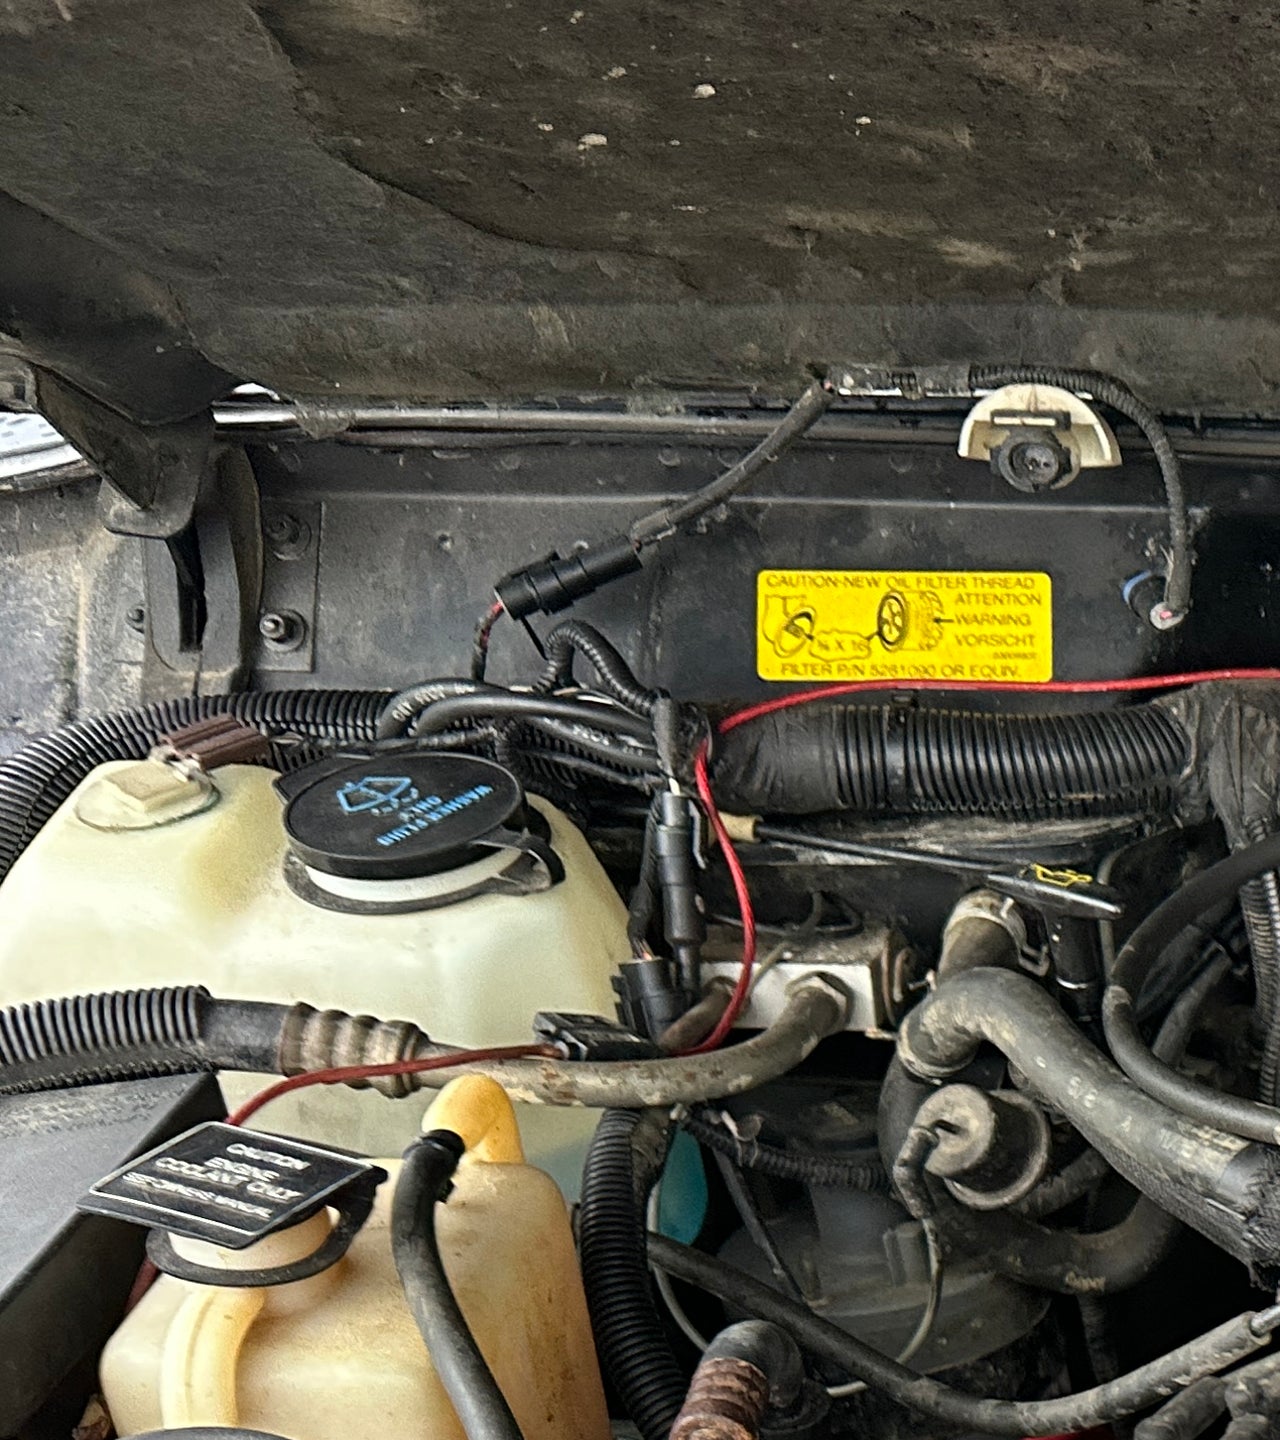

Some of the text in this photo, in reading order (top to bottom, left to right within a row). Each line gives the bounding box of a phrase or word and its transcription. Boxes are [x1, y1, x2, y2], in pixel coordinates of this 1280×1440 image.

[885, 575, 911, 590] OIL
[916, 575, 966, 590] FILTER
[968, 576, 1035, 590] THREAD
[954, 592, 1042, 607] ATTENTION
[954, 613, 1032, 627] WARNING
[954, 634, 1036, 648] VORSICHT
[780, 664, 832, 678] FILTER
[940, 664, 965, 678] OR
